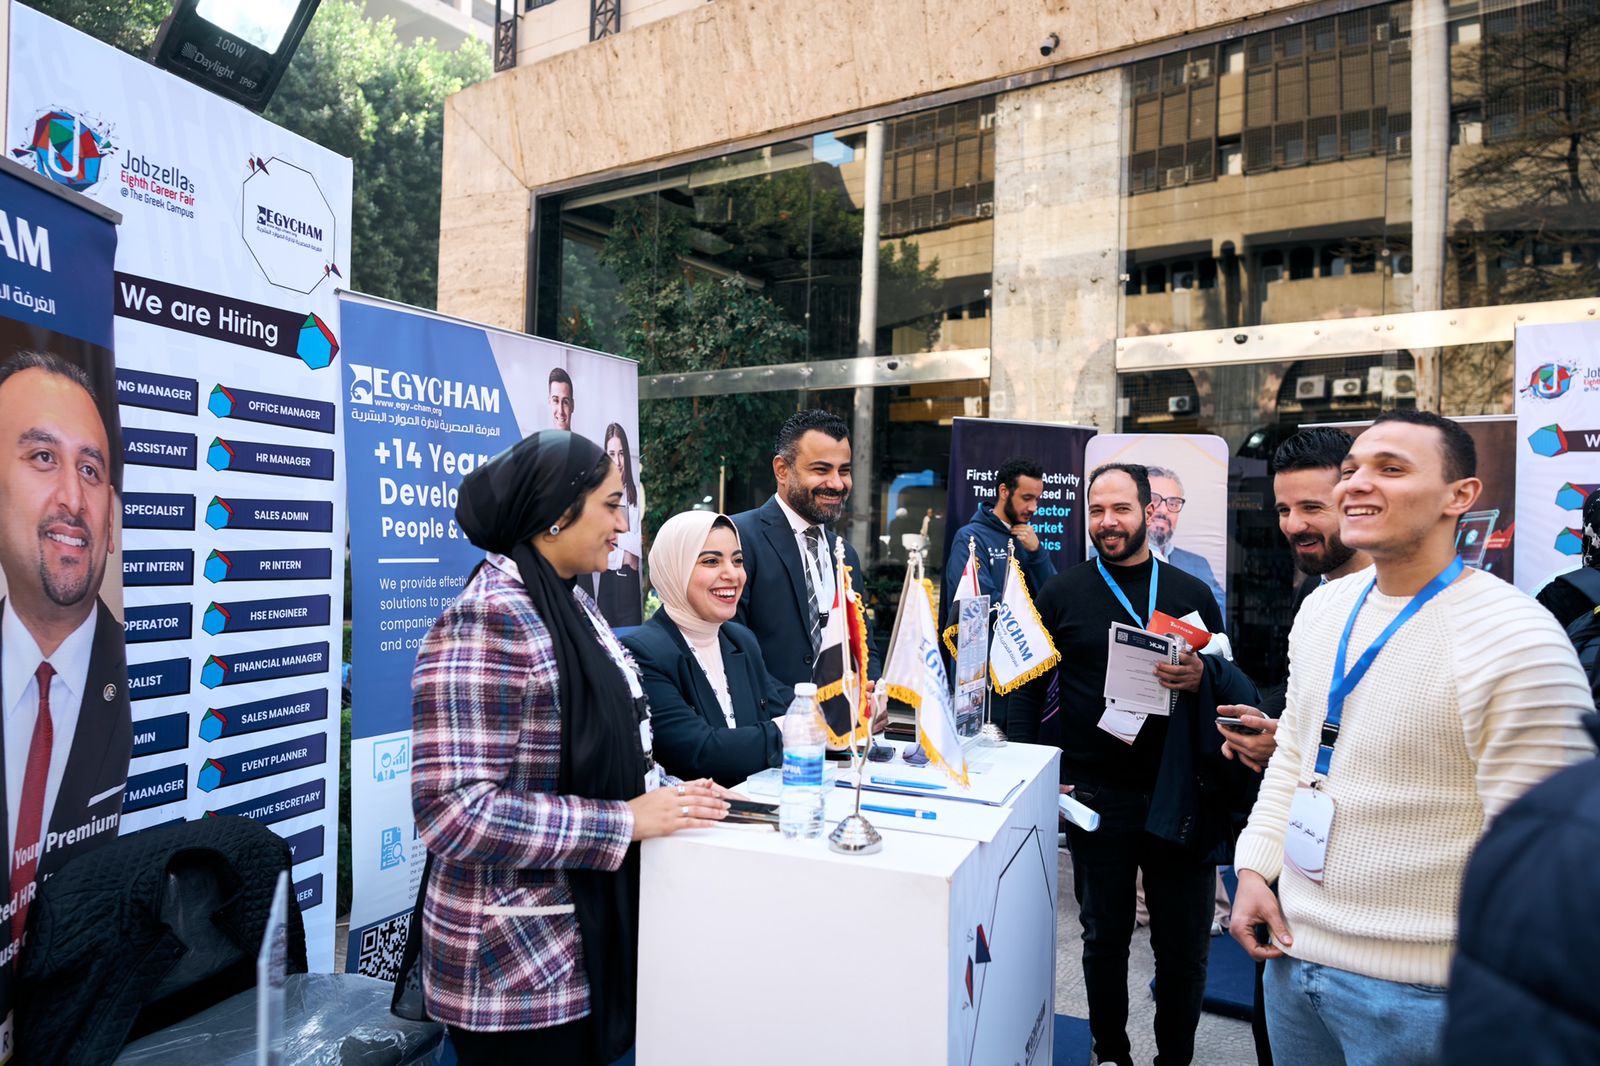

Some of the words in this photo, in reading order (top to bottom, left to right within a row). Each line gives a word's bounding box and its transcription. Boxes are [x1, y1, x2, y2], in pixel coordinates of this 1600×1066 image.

[215, 36, 247, 59] 100W
[194, 52, 235, 79] Daylight
[239, 76, 258, 89] IP67
[120, 170, 149, 190] Eighth
[150, 180, 178, 200] Career
[179, 191, 195, 206] Fair
[120, 187, 129, 197] @
[130, 188, 143, 201] The
[144, 193, 165, 208] Greek
[166, 201, 194, 219] Campus
[266, 208, 323, 241] EGYCHAM
[13, 285, 56, 315] الغرفة
[120, 281, 163, 315] We
[170, 300, 211, 327] are
[218, 306, 279, 348] Hiring
[116, 379, 136, 393] NG
[137, 382, 192, 401] MANAGER
[373, 367, 500, 414] EGYCHAM
[248, 400, 279, 415] OFFICE
[280, 405, 321, 420] MANAGER
[351, 408, 387, 423] البشرية
[375, 399, 443, 416] www.egy-cham.org
[388, 414, 420, 427] الموارد
[440, 419, 474, 434] المصرية
[475, 423, 500, 437] الغرفة
[128, 441, 188, 457] ASSISTANT
[1584, 433, 1600, 448] W
[256, 452, 269, 464] HR
[269, 453, 311, 467] MANAGER
[374, 437, 423, 469] +14
[428, 442, 496, 476] Year
[966, 468, 992, 481] First
[1041, 472, 1080, 488] Activity
[379, 477, 459, 509] Develo
[1039, 489, 1061, 500] sed
[1066, 489, 1075, 500] in
[124, 504, 185, 516] SPECIALIST
[254, 510, 280, 520] SALES
[281, 511, 309, 521] ADMIN
[381, 516, 444, 545] People
[448, 519, 458, 539] &
[1027, 521, 1064, 534] arket
[146, 561, 184, 572] INTERN
[259, 561, 271, 570] PR
[272, 560, 301, 570] INTERN
[379, 577, 397, 590] We
[400, 576, 437, 593] provide
[380, 596, 427, 610] solutions
[430, 596, 439, 607] to
[250, 609, 267, 621] HSE
[268, 607, 308, 620] ENGINEER
[380, 615, 437, 633] companies
[380, 637, 402, 652] and
[234, 659, 281, 673] FINANCIAL
[281, 652, 322, 667] MANAGER
[241, 710, 268, 725] SALES
[269, 702, 311, 719] MANAGER
[134, 731, 156, 745] MIN
[241, 758, 270, 773] EVENT
[270, 748, 308, 766] PLANNER
[129, 779, 185, 802] MANAGER
[238, 804, 274, 820] CUTIVE
[275, 790, 321, 812] SECRETARY
[15, 841, 40, 870] Your
[46, 812, 119, 854] Premium
[19, 881, 37, 909] HR
